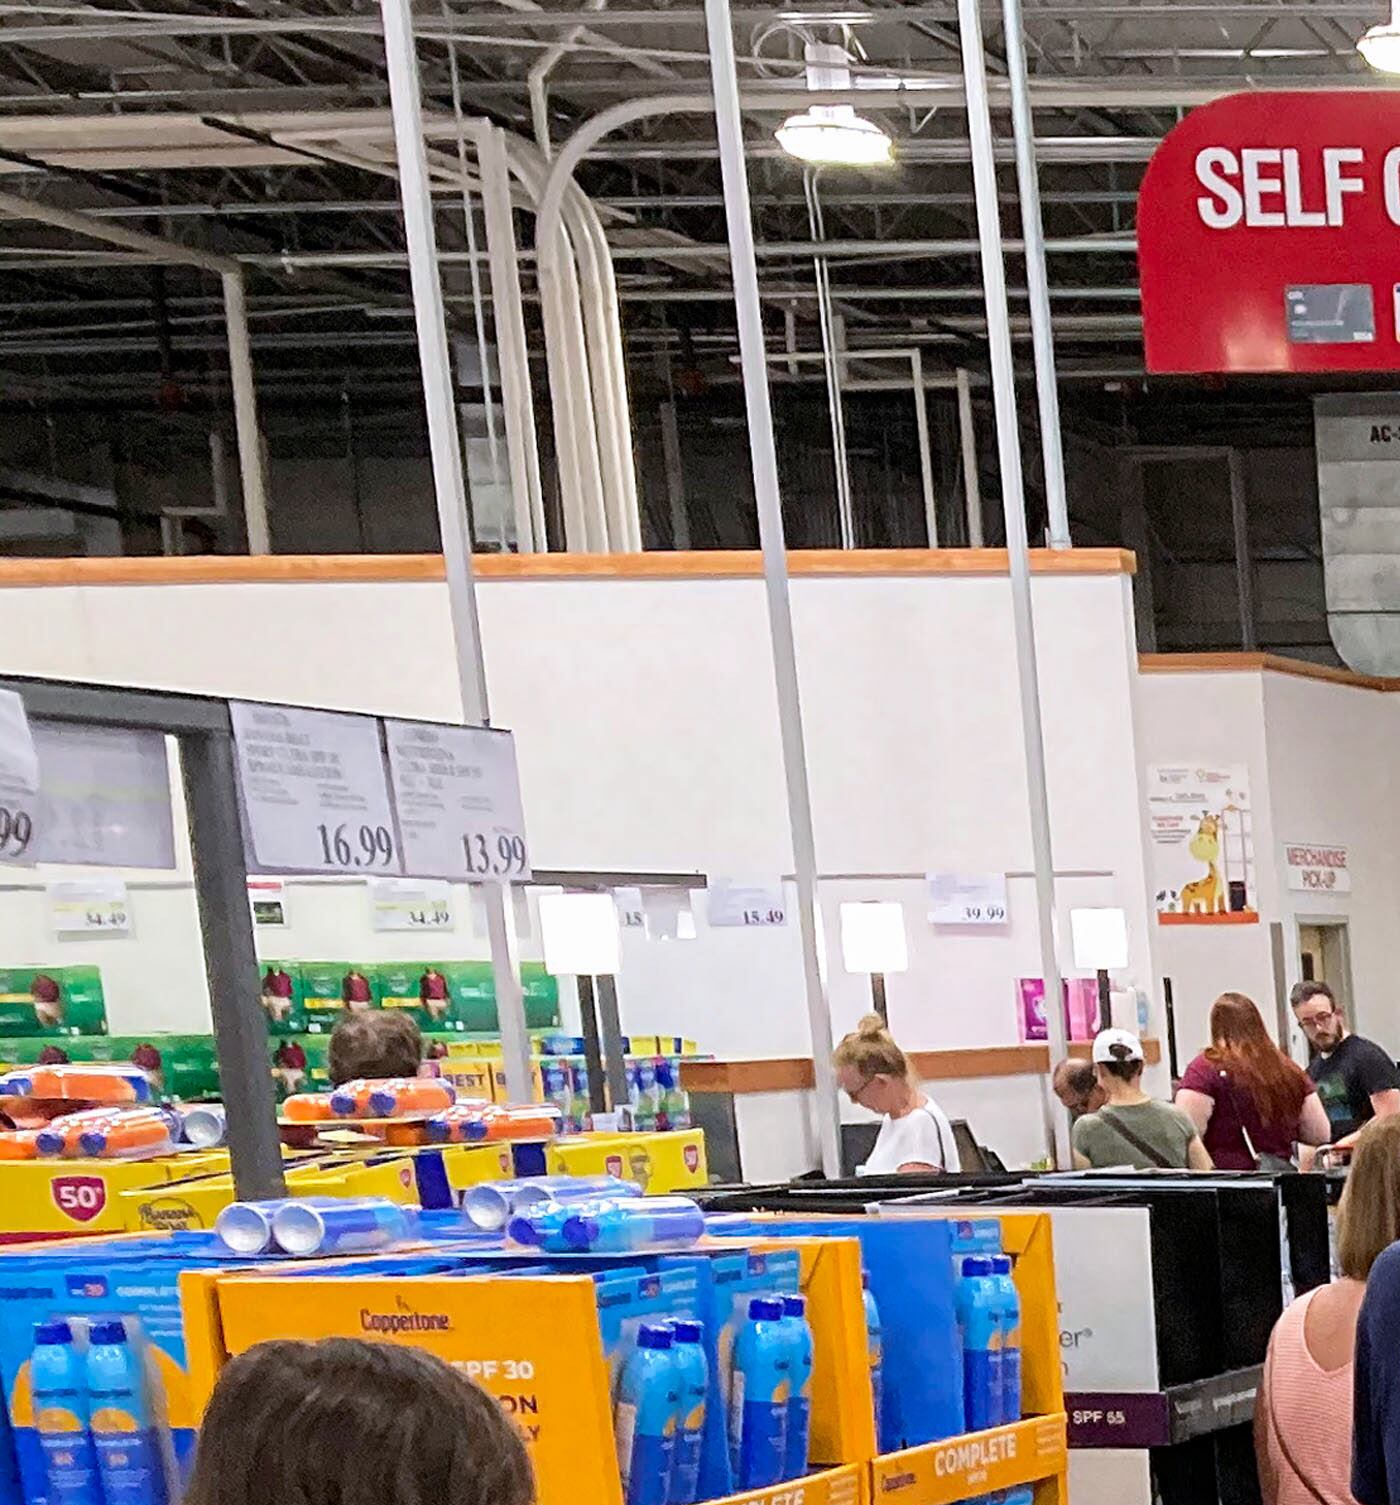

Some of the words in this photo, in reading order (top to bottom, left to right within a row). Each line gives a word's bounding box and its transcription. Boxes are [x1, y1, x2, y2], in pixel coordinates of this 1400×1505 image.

[1197, 146, 1364, 229] SELF
[0, 807, 31, 857] 99
[318, 824, 392, 866] 16.99
[463, 833, 526, 874] 13.99
[1287, 848, 1346, 868] MERCHANDISE
[743, 911, 783, 926] 15.49
[361, 1309, 449, 1333] Coppertone
[502, 1360, 534, 1379] 30
[1073, 1410, 1104, 1424] SPF
[935, 1433, 1017, 1477] COMPLETE
